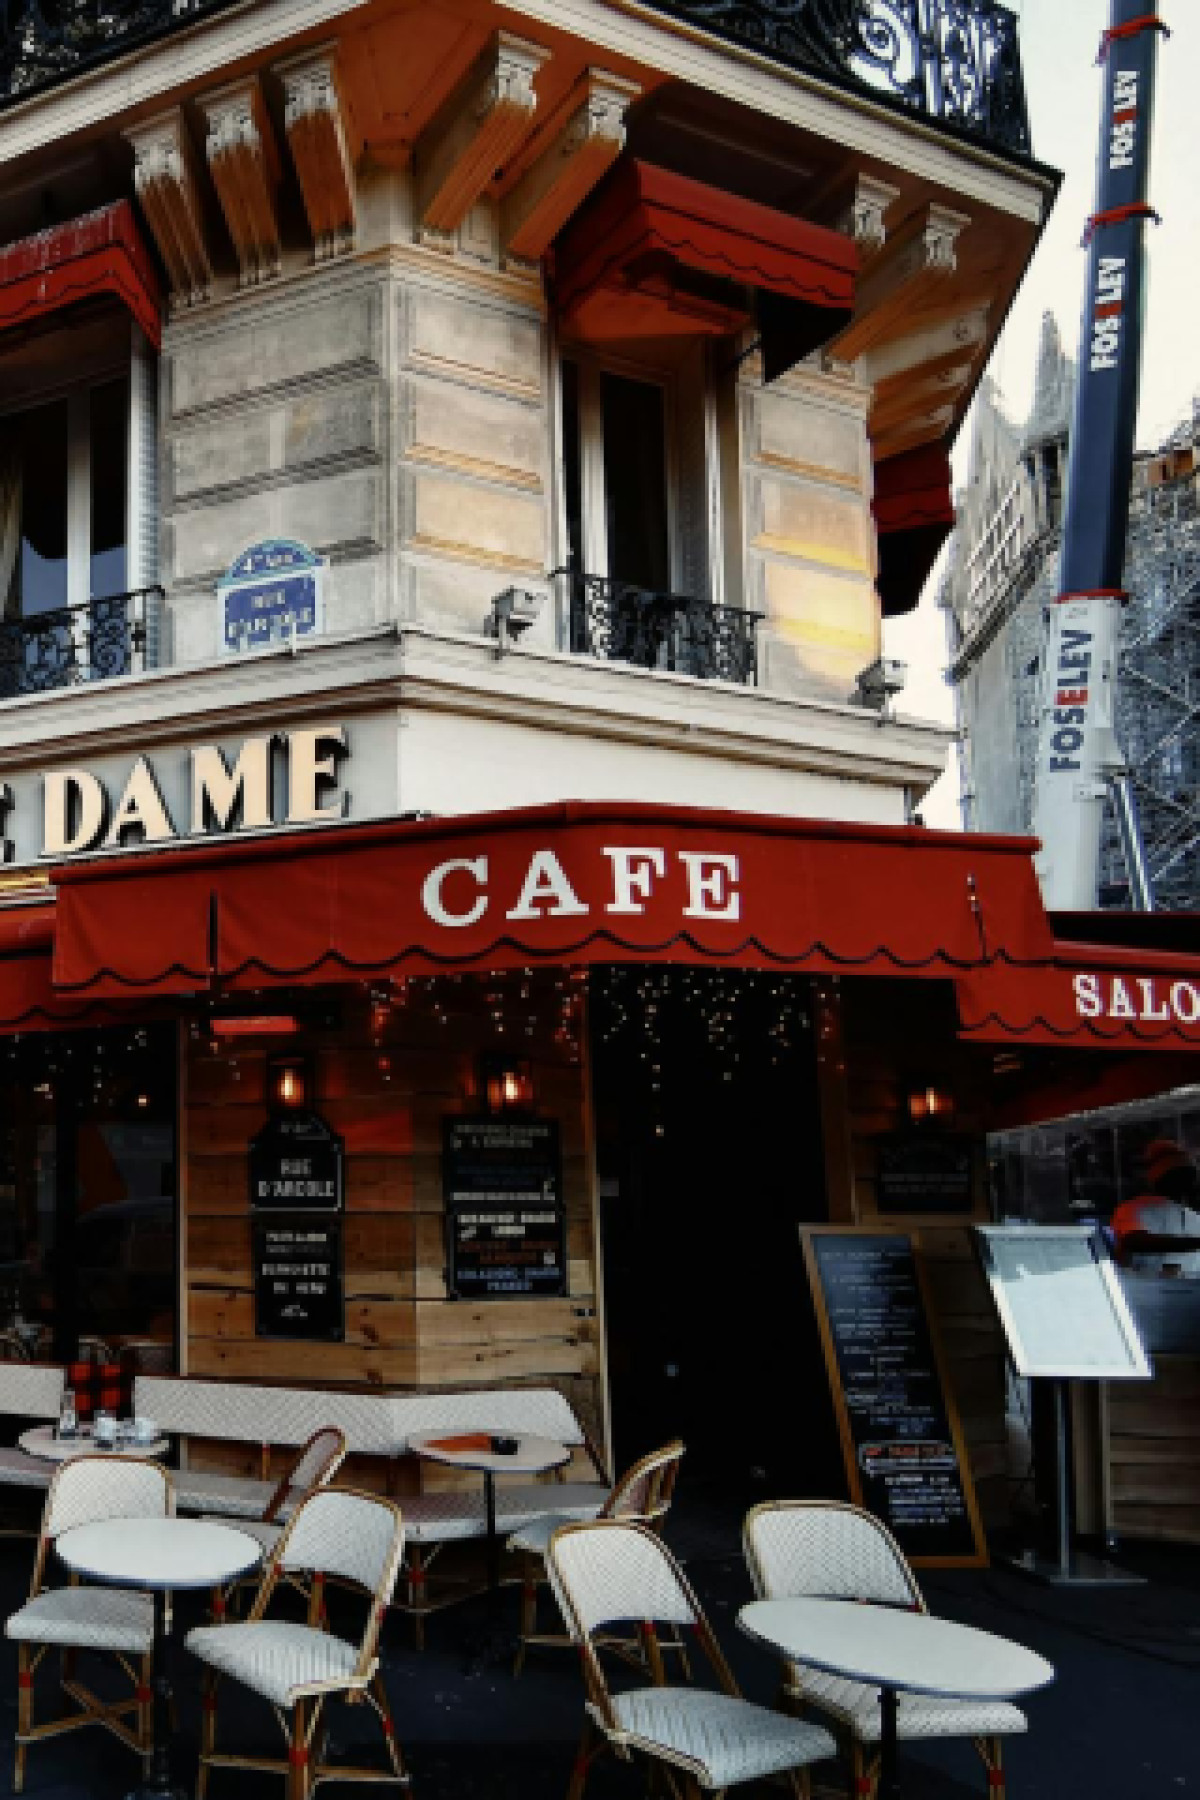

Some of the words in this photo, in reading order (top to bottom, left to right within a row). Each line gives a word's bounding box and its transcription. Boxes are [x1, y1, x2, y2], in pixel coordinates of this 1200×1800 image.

[1050, 629, 1093, 771] FOSELEV
[41, 726, 347, 856] DAME
[421, 847, 740, 927] CAFE
